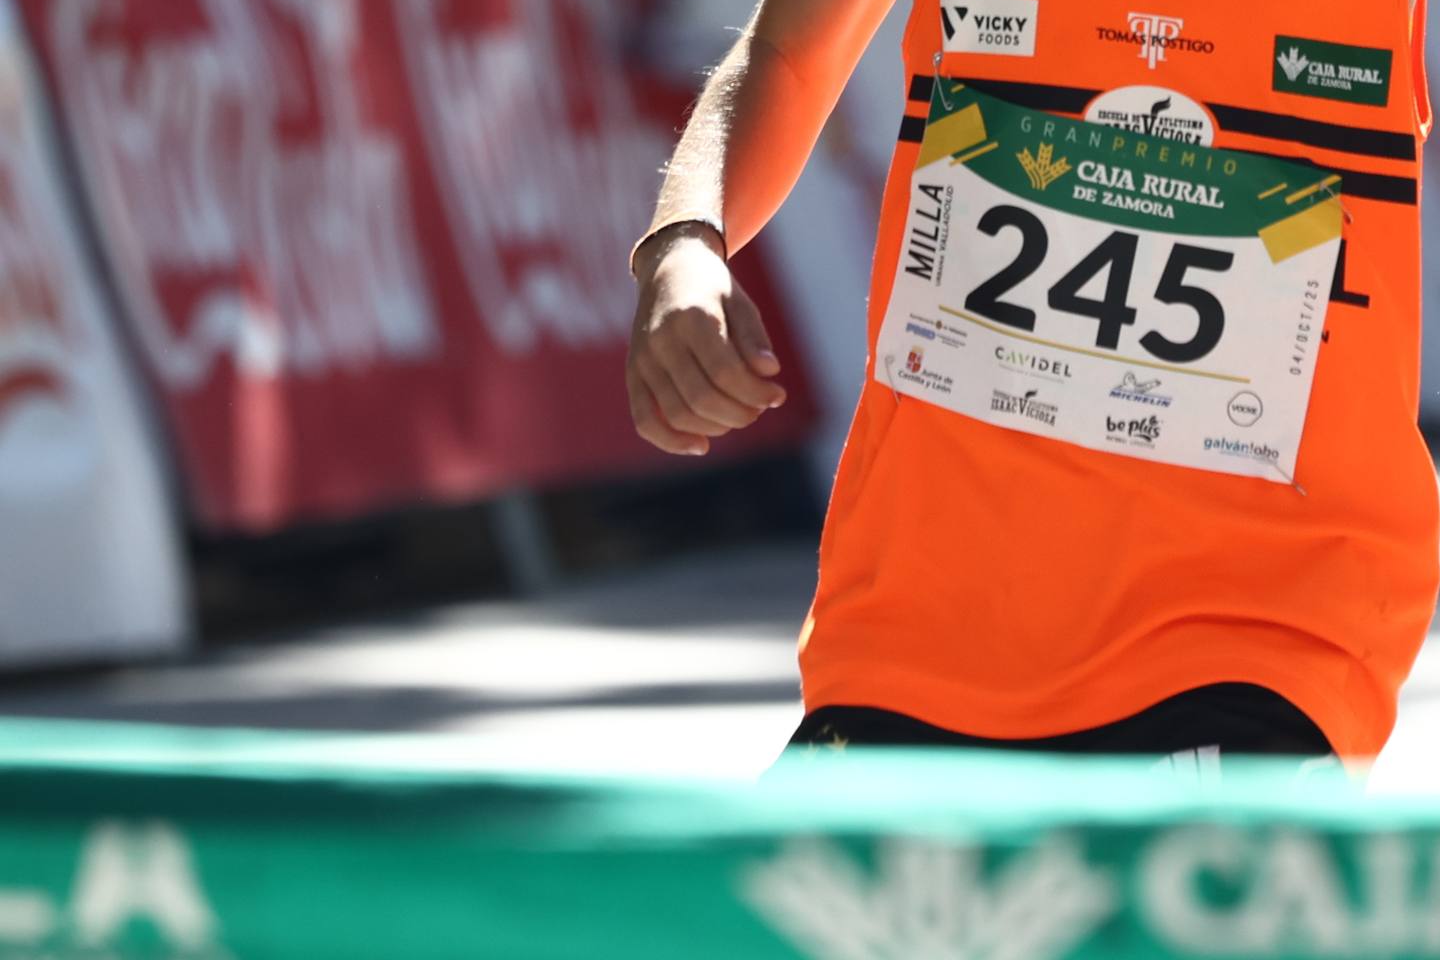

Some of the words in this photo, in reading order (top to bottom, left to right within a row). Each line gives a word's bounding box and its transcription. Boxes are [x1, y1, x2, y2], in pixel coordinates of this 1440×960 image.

[974, 15, 1027, 32] VICKY
[978, 33, 1020, 46] FOODS
[1151, 35, 1215, 54] POSTIGO
[1307, 75, 1319, 86] DE
[1320, 78, 1352, 91] ZAMORA
[1308, 61, 1336, 78] CAJA
[1338, 65, 1383, 85] RURAL
[1098, 109, 1129, 122] ESCUELA
[1132, 114, 1141, 124] DE
[1158, 116, 1204, 130] ATLETISMO
[1077, 160, 1136, 192] CAJA
[1141, 173, 1224, 208] RURAL
[1072, 185, 1097, 203] DE
[1101, 191, 1175, 220] ZAMORA
[939, 185, 954, 251] VALLADOLID
[905, 184, 944, 281] MILLA
[964, 204, 1234, 364] 245
[995, 346, 1072, 378] CAVIDEL
[1109, 390, 1172, 408] MICHELIN
[1106, 415, 1125, 432] be
[1128, 417, 1160, 439] plus
